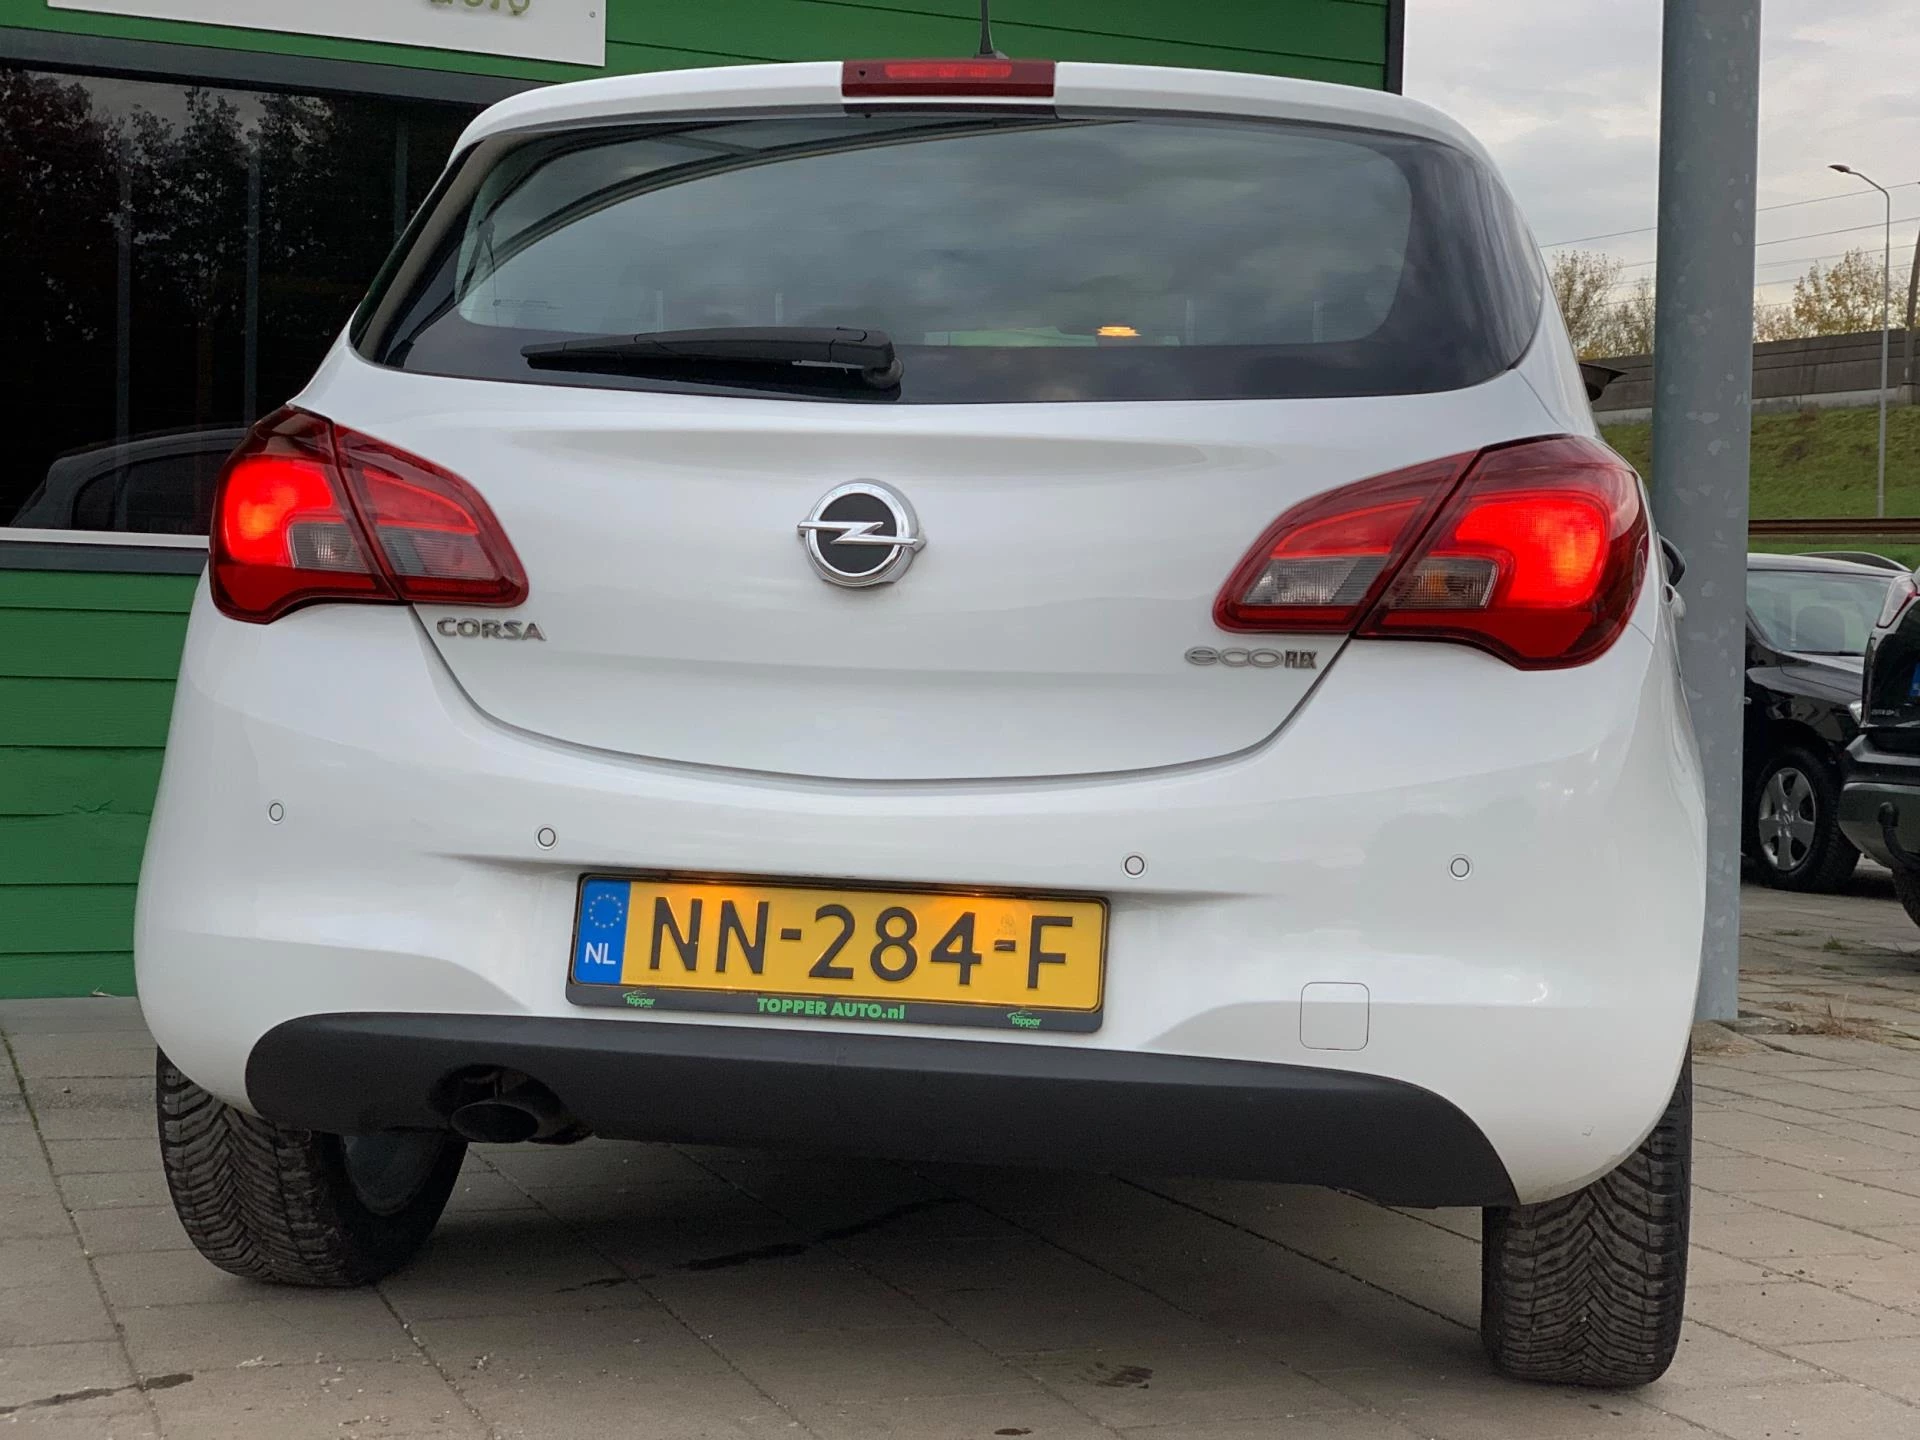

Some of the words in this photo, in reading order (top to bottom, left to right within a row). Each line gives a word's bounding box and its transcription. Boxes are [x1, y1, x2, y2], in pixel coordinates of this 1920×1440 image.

[437, 617, 547, 641] CORSA
[584, 941, 617, 965] NL
[649, 896, 1073, 989] NN-284-F
[757, 998, 827, 1015] TOPPER
[830, 1002, 905, 1020] AUTO.nl
